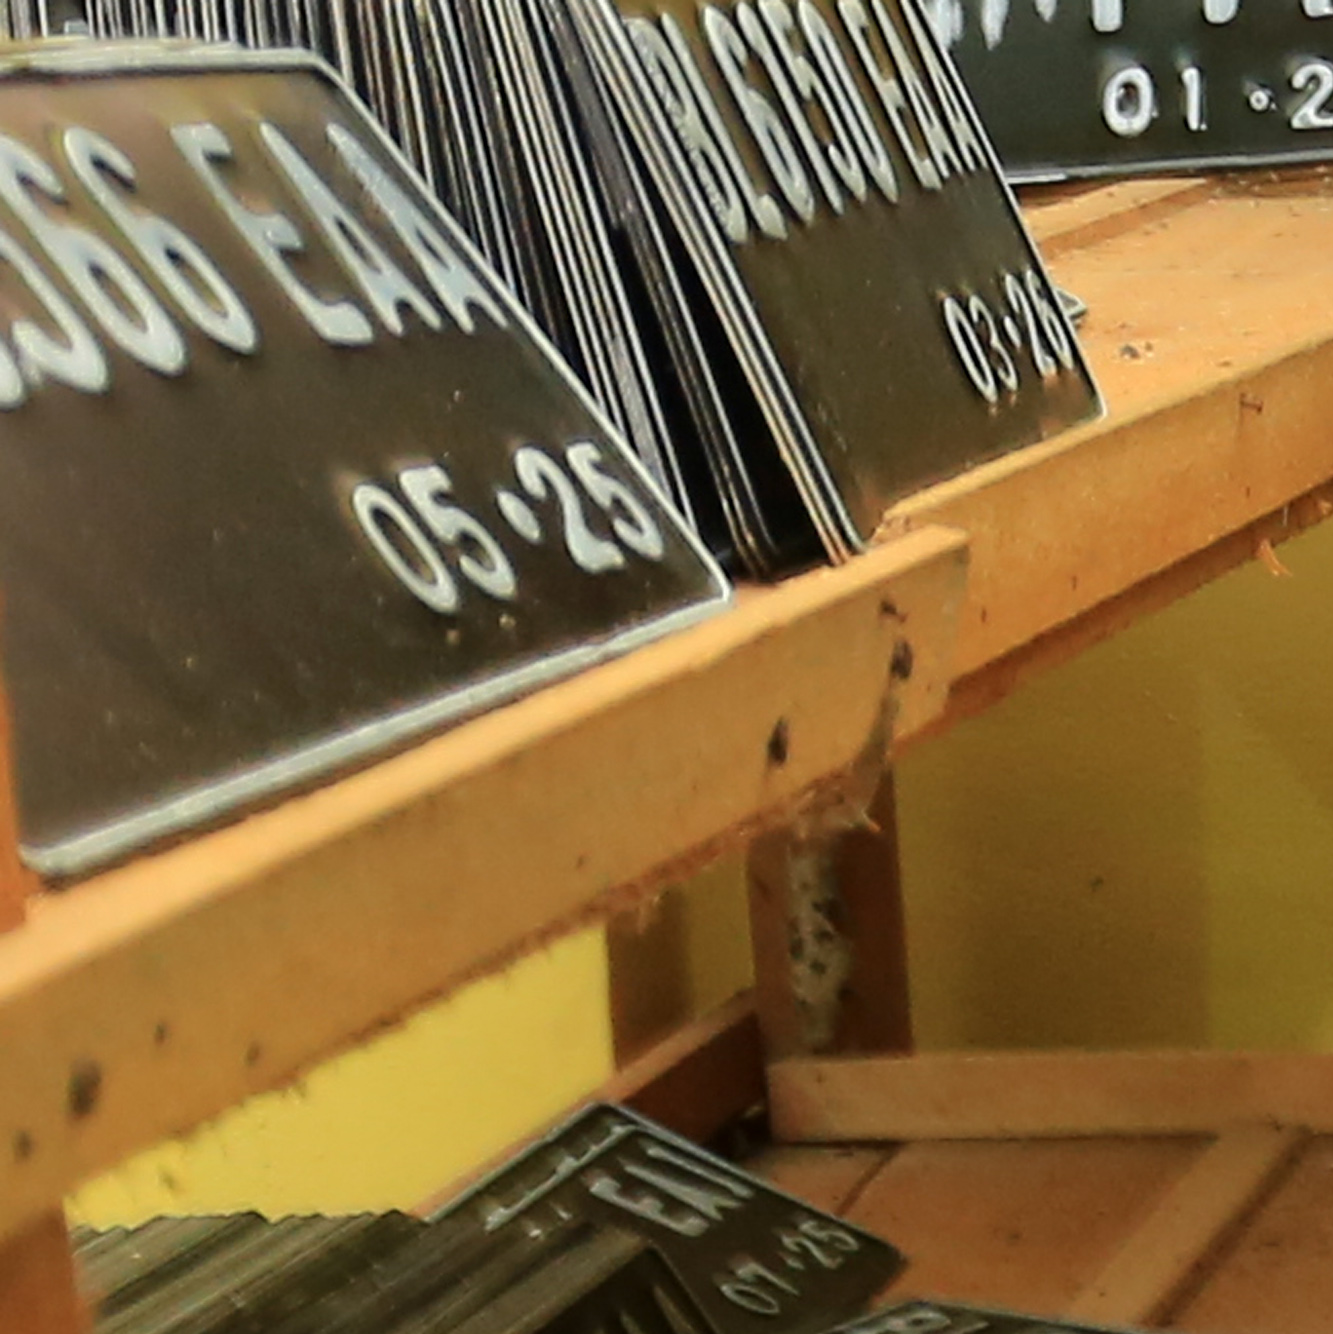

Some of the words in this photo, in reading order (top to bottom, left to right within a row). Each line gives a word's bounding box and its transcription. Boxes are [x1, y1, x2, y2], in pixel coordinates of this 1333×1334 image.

[624, 12, 788, 244] BL
[704, 0, 898, 224] 6150
[839, 0, 990, 190] EAA
[169, 121, 509, 346] EAA
